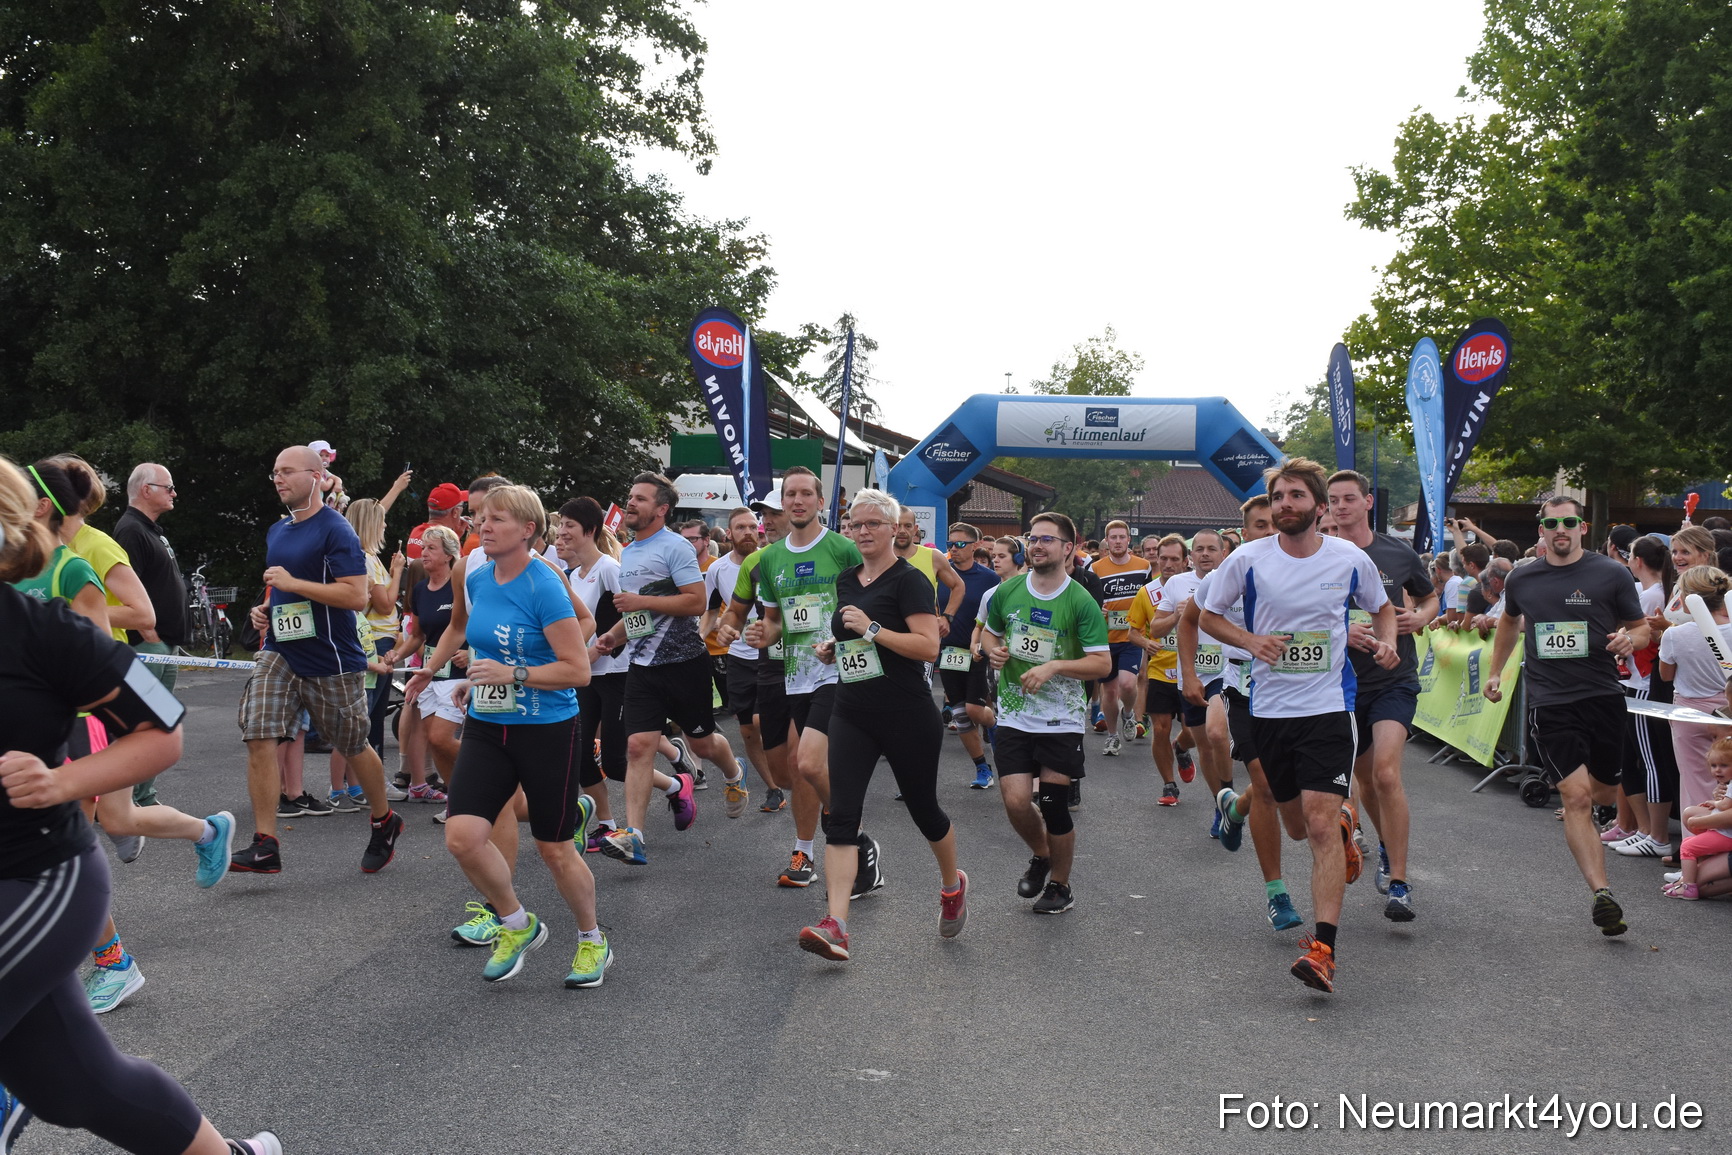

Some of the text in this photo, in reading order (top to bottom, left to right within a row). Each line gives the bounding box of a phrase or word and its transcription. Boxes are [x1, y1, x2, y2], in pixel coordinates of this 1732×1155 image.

[1459, 345, 1502, 371] Hervis
[1073, 427, 1147, 442] firmenlauf
[932, 448, 971, 458] Fischer
[785, 574, 836, 588] firmenlauf
[625, 614, 648, 630] 1930
[793, 608, 808, 622] 40
[278, 616, 302, 631] 810
[1021, 637, 1039, 653] 39
[1163, 636, 1178, 645] 16
[1546, 635, 1576, 648] 405
[1705, 636, 1724, 660] swn
[946, 654, 964, 664] 813
[1282, 646, 1323, 661] 1839
[148, 656, 212, 668] Raiffeisenbank
[841, 653, 868, 672] 845
[476, 684, 507, 700] 1729
